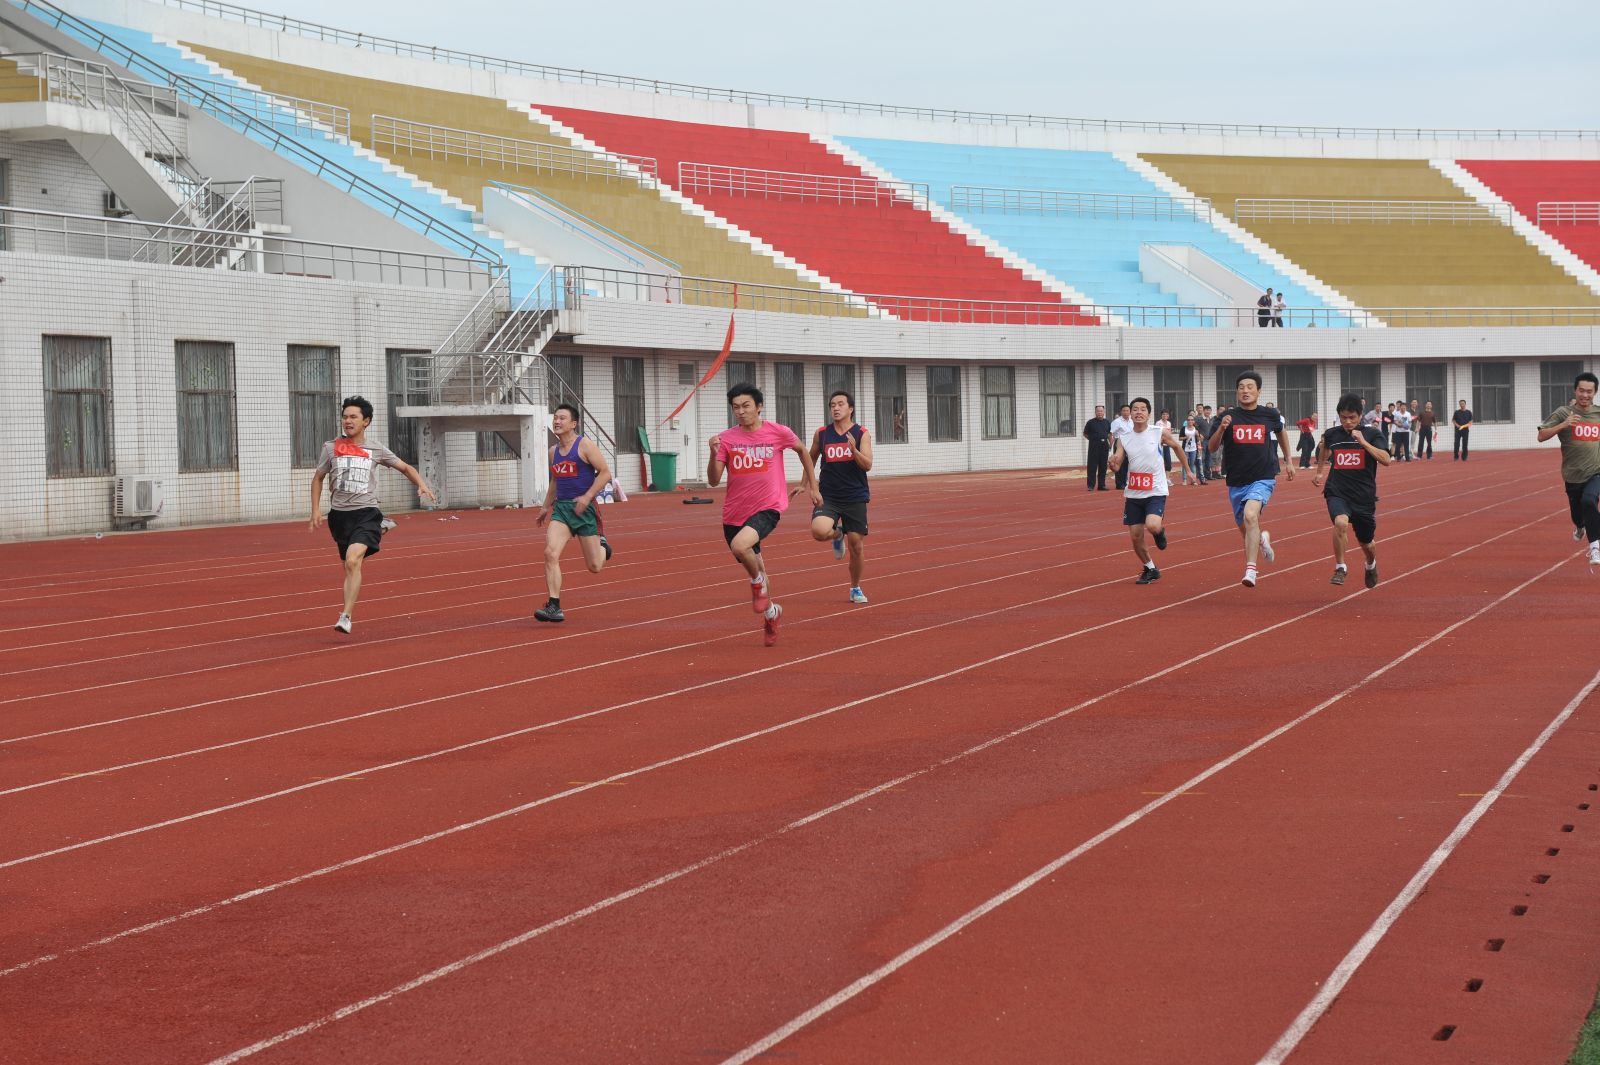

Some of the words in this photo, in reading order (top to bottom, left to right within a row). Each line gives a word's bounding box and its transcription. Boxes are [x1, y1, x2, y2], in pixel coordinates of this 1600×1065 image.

[1235, 427, 1263, 441] 014
[1575, 425, 1599, 438] 009
[827, 446, 853, 459] 004
[1336, 452, 1361, 466] 025
[733, 454, 764, 470] 005
[1130, 475, 1151, 487] 018
